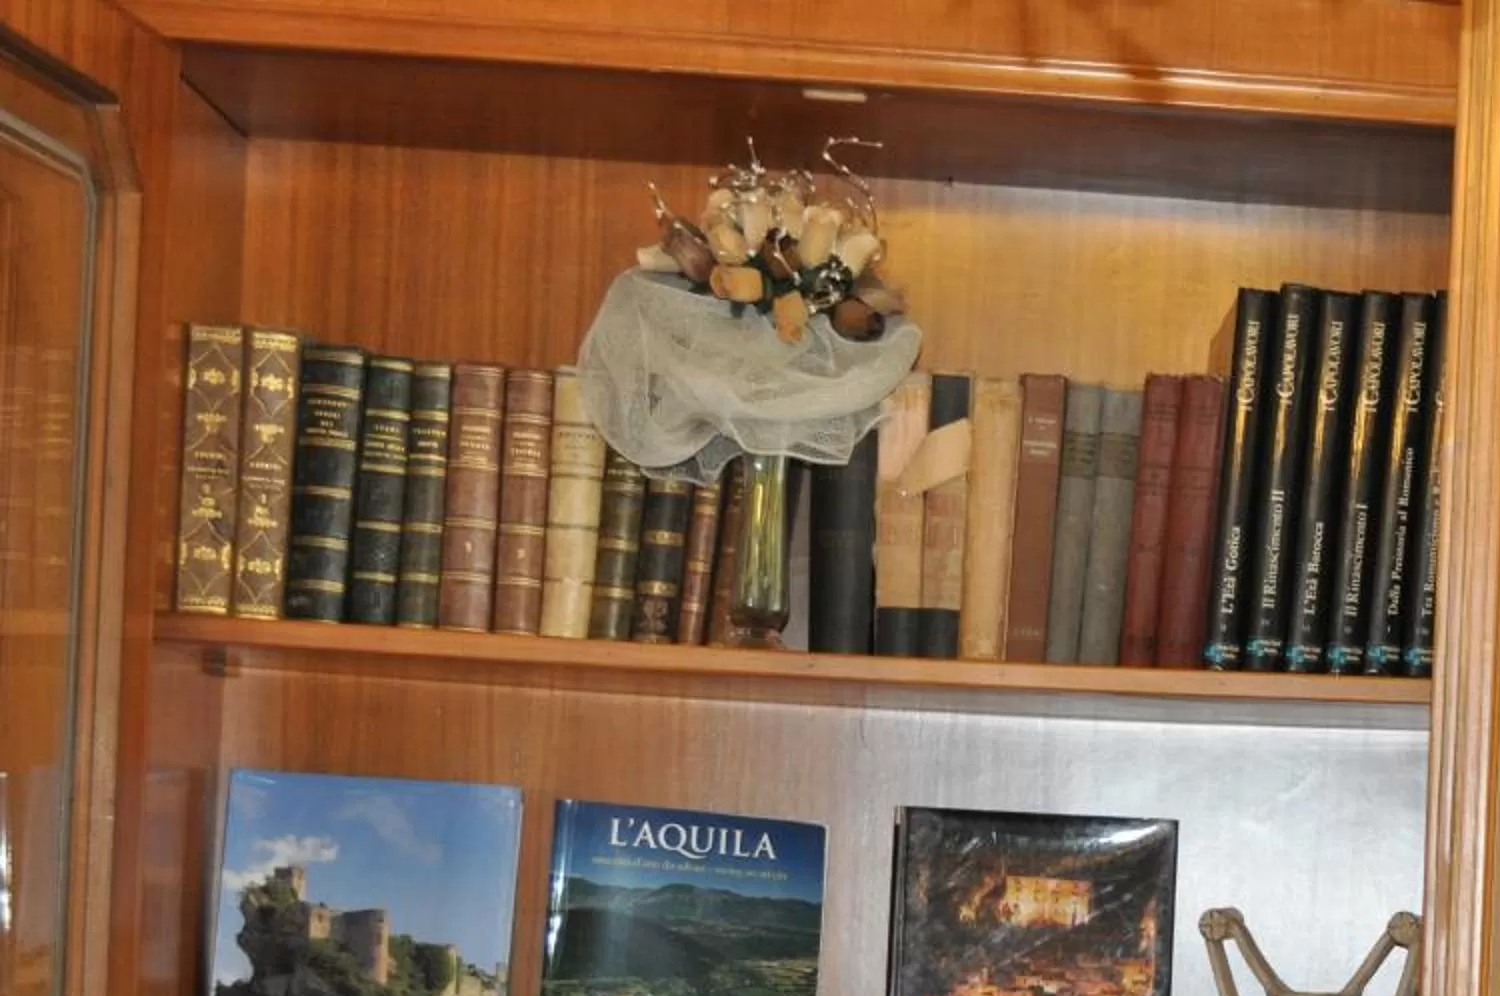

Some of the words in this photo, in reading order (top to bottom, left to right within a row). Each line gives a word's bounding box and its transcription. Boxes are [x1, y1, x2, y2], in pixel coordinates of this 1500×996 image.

[1263, 503, 1284, 597] Rinascimento
[1346, 510, 1367, 604] Rinascimento
[608, 817, 777, 861] L'AQUILA
